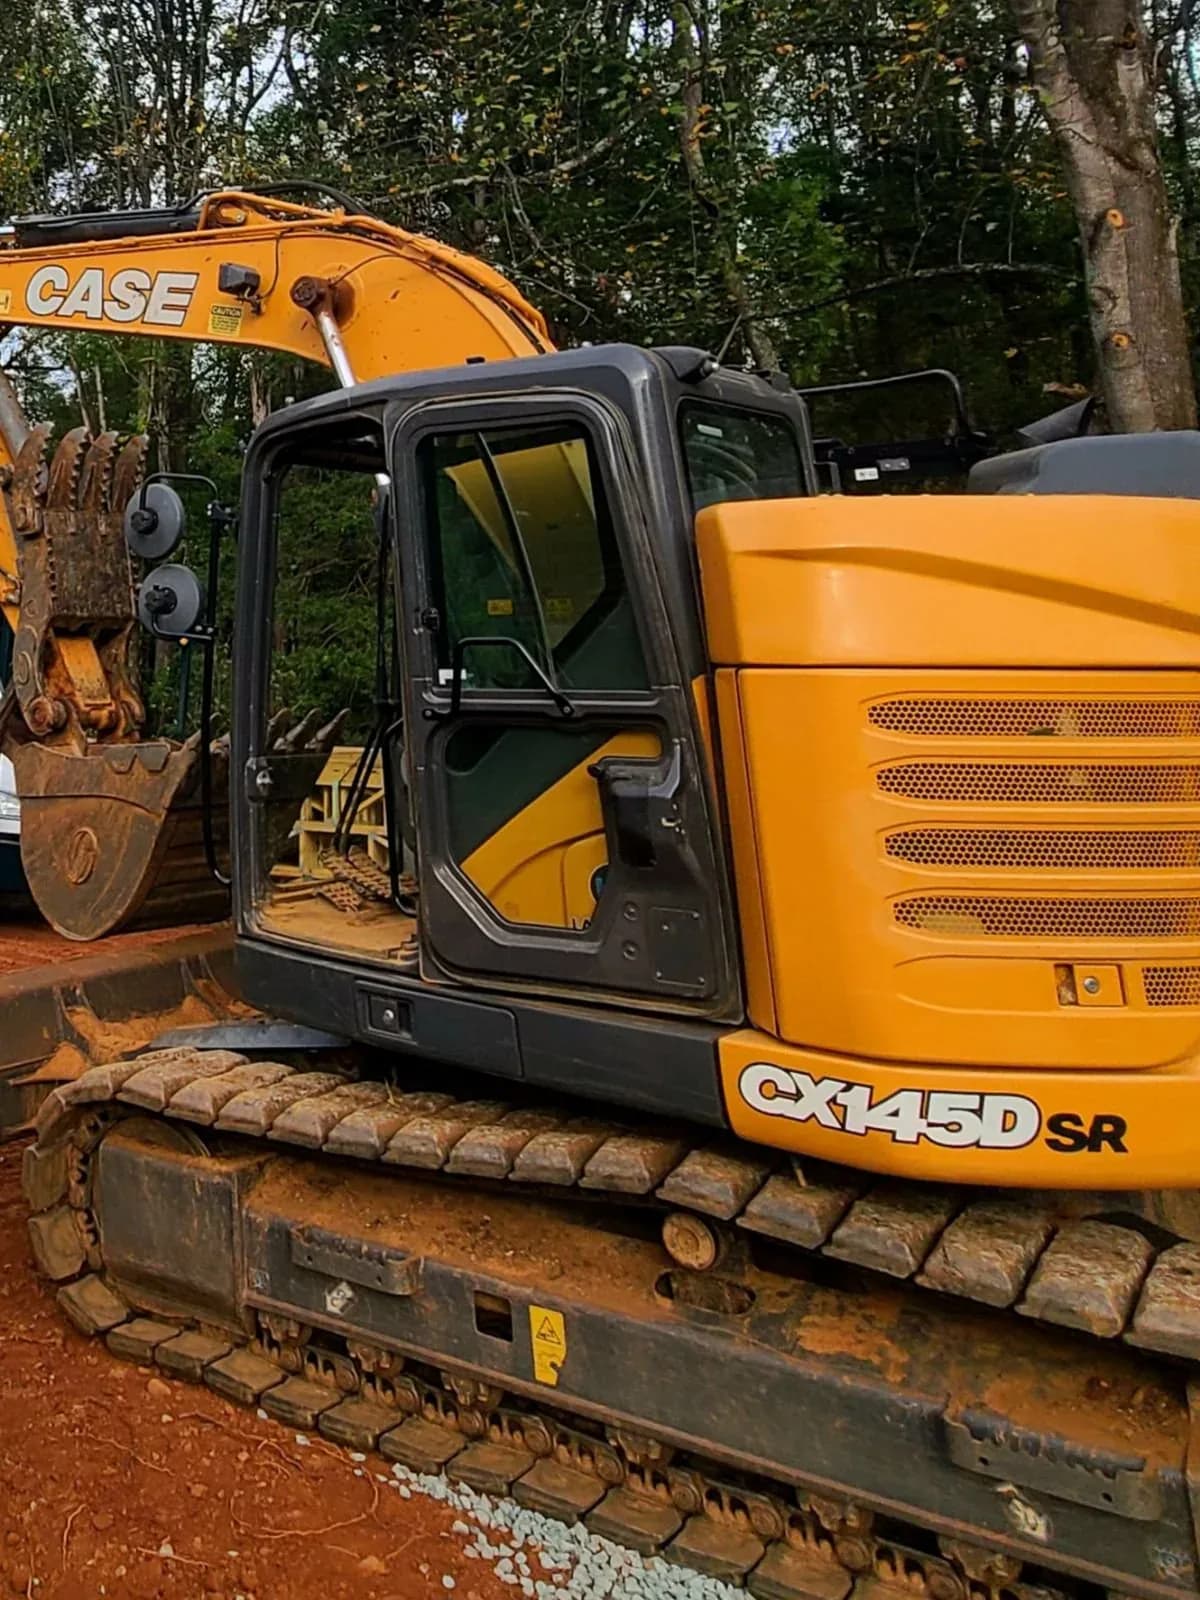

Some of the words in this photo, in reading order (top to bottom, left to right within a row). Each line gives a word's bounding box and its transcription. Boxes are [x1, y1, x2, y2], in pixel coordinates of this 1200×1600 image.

[26, 265, 199, 326] CASE
[212, 306, 241, 317] CAUTION
[738, 1062, 1042, 1149] CX145D
[1045, 1113, 1129, 1154] SR
